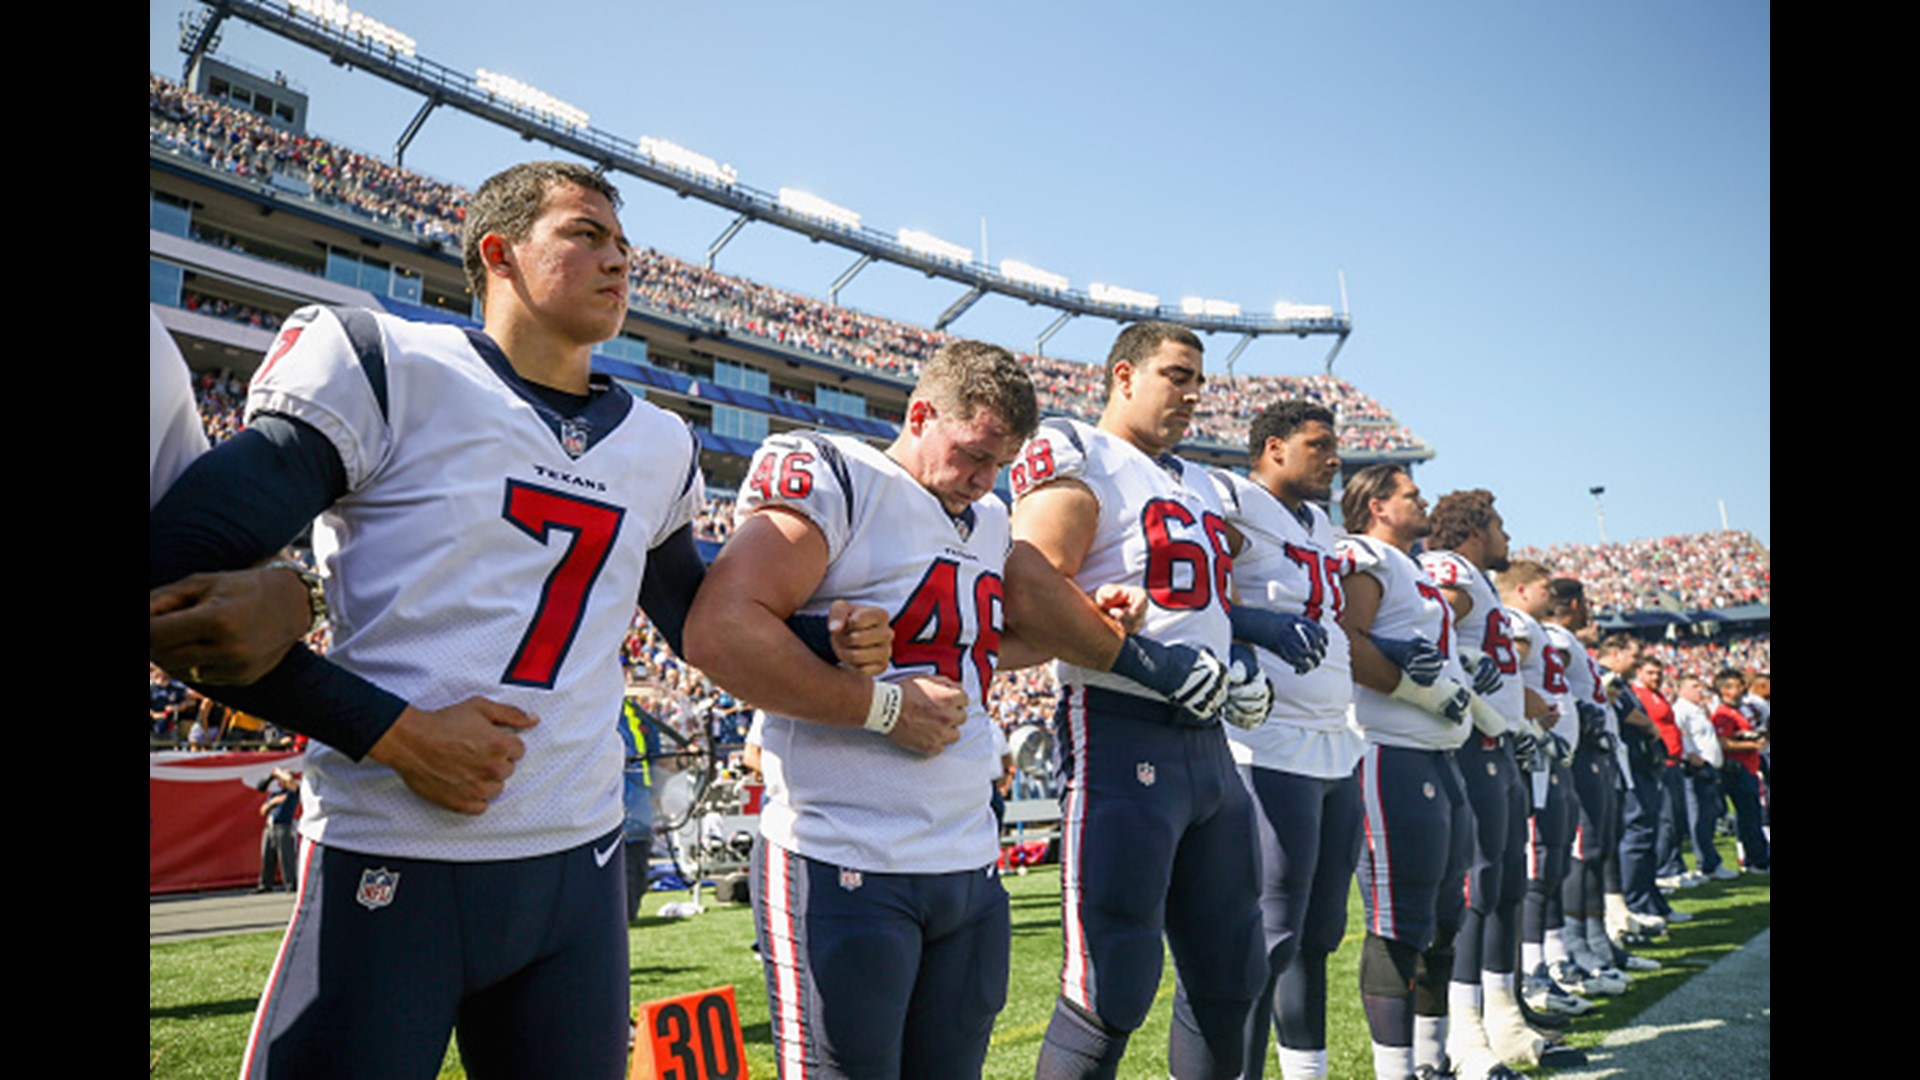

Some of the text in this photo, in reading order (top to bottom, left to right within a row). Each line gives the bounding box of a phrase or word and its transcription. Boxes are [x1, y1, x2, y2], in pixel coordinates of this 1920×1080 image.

[533, 464, 607, 492] TEXANS
[750, 452, 815, 500] 46
[501, 477, 627, 690] 7
[656, 993, 743, 1080] 30
